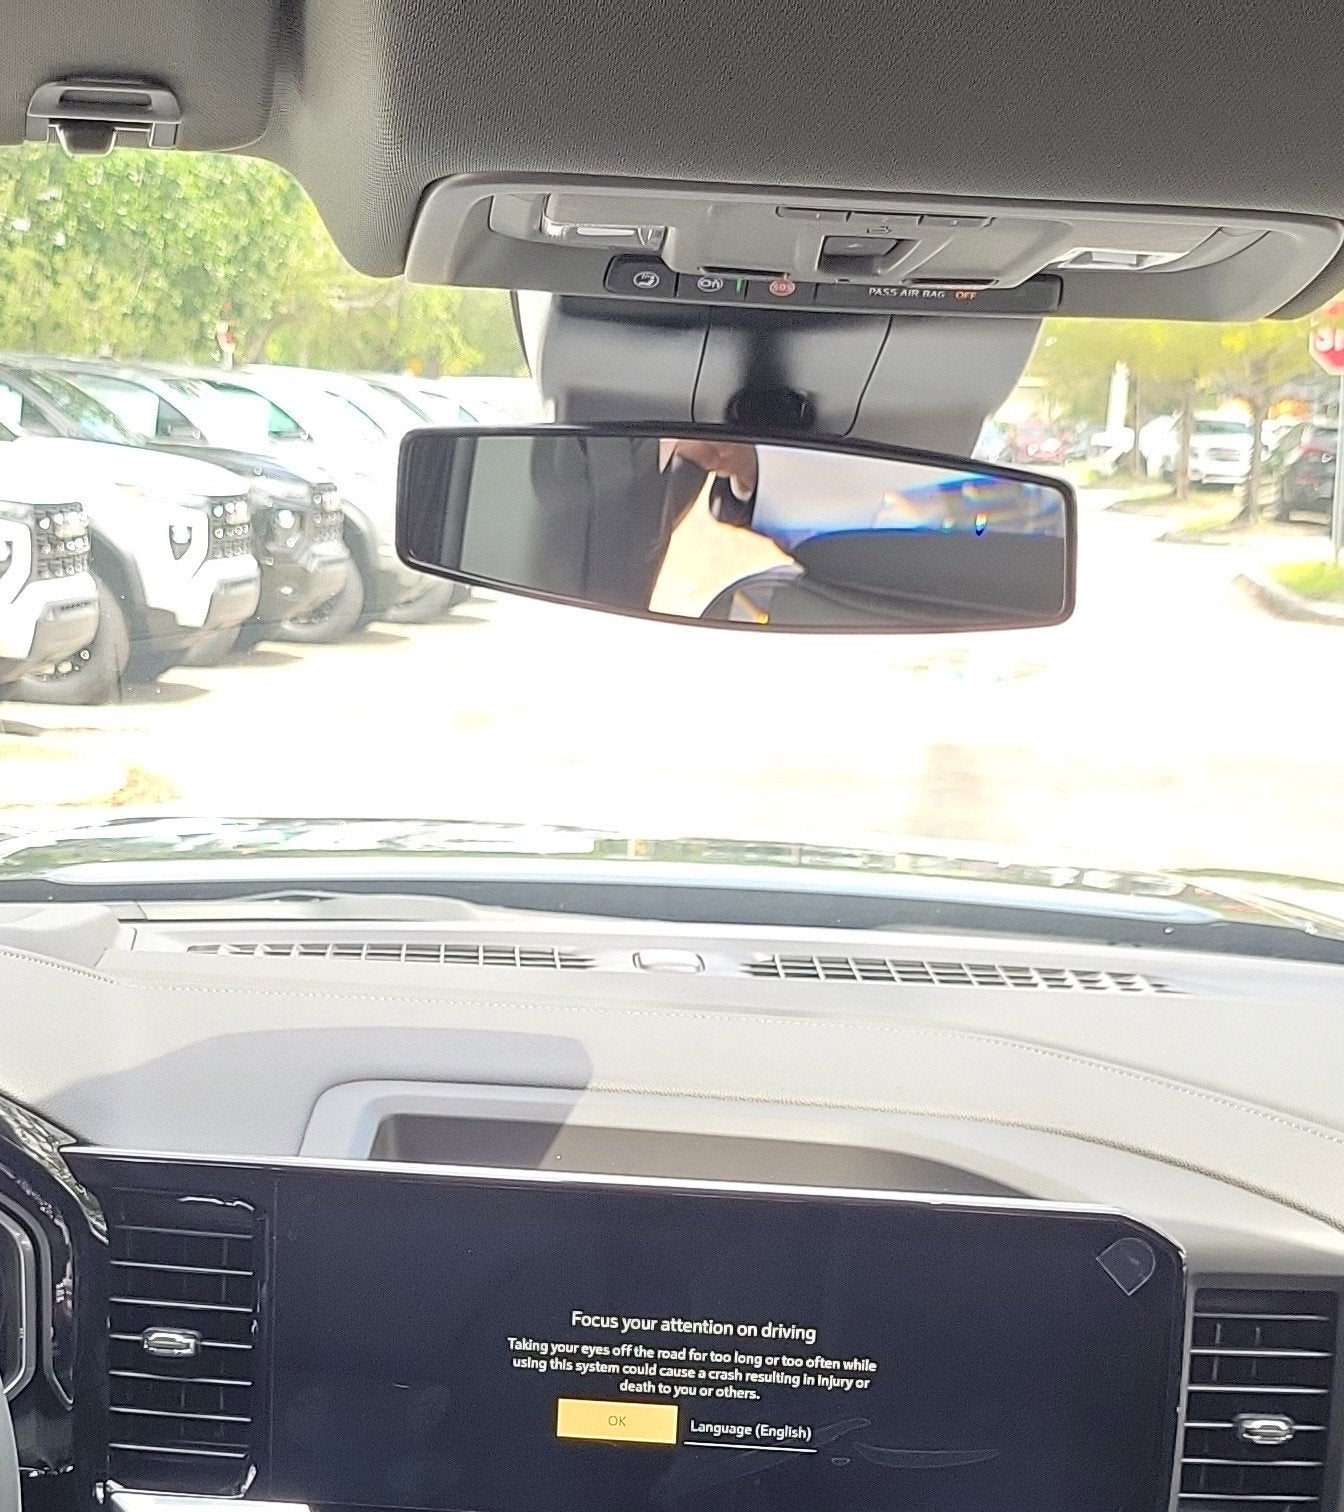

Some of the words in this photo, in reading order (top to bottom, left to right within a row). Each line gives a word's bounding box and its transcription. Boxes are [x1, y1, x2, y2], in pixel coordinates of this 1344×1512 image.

[868, 287, 897, 297] PASS
[899, 289, 918, 299] AIR
[922, 290, 947, 300] BAG
[955, 291, 978, 301] OFF
[571, 1310, 619, 1328] Focus
[620, 1317, 658, 1333] your
[660, 1316, 734, 1335] attention
[736, 1323, 758, 1337] on
[760, 1321, 817, 1345] driving
[507, 1337, 549, 1354] Taking
[550, 1341, 579, 1356] your
[580, 1343, 610, 1358] eyes
[611, 1343, 633, 1357] off
[633, 1345, 655, 1359] the
[657, 1346, 687, 1360] road
[688, 1348, 709, 1362] for
[709, 1351, 732, 1363] too
[733, 1350, 763, 1368] long
[764, 1355, 780, 1366] or
[781, 1354, 804, 1367] too
[805, 1355, 841, 1370] often
[842, 1358, 878, 1372] while
[512, 1356, 547, 1372] using
[549, 1358, 574, 1371] this
[574, 1360, 620, 1375] system
[621, 1362, 657, 1376] could
[658, 1366, 696, 1379] cause
[697, 1369, 706, 1379] a
[707, 1368, 743, 1382] crash
[744, 1370, 801, 1388] resulting
[802, 1373, 815, 1386] in
[816, 1374, 855, 1391] injury
[855, 1379, 871, 1389] or
[619, 1378, 656, 1393] death
[657, 1381, 672, 1394] to
[672, 1384, 698, 1398] you
[698, 1386, 715, 1397] or
[715, 1385, 761, 1400] others.
[607, 1415, 627, 1427] OK
[690, 1419, 753, 1438] Language
[754, 1422, 812, 1442] (English)
